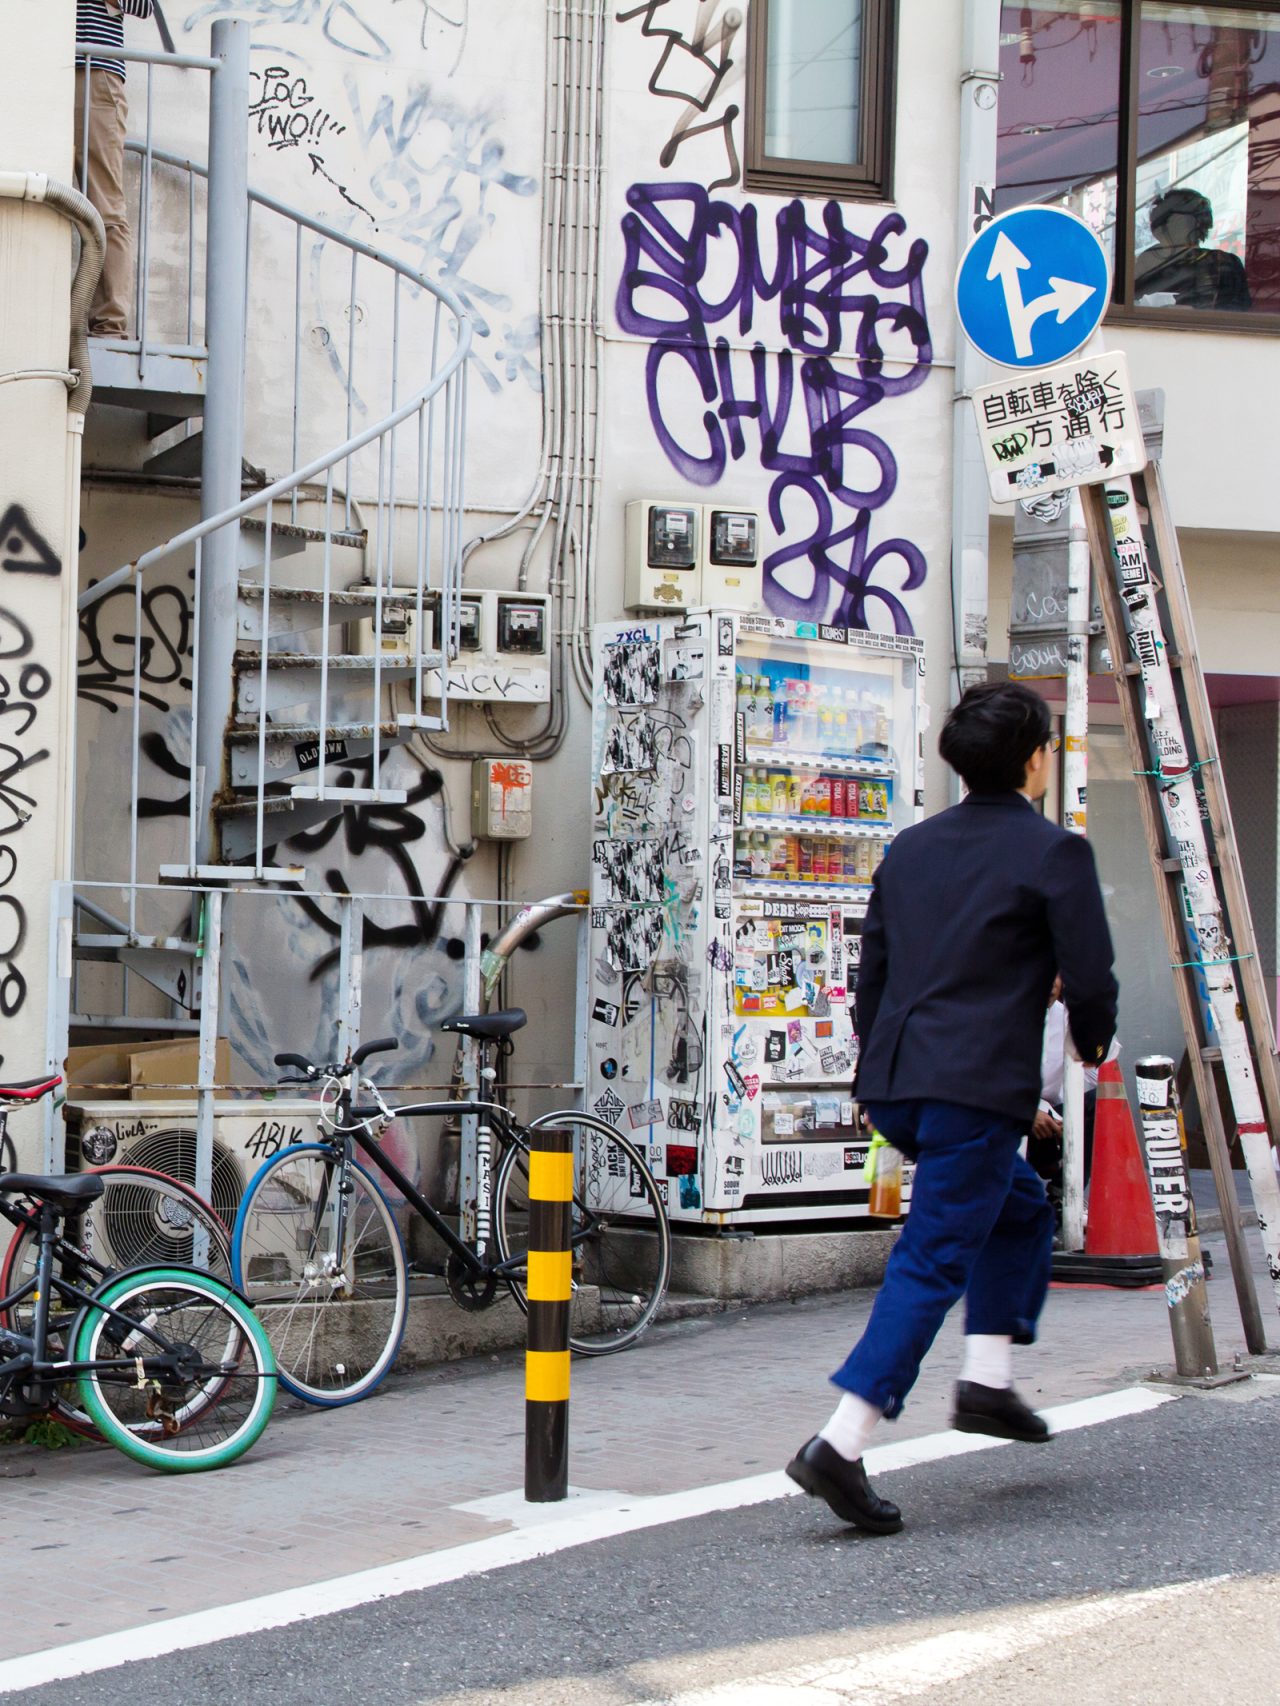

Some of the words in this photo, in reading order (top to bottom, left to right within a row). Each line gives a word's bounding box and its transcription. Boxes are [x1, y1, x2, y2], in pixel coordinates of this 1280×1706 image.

[982, 369, 1121, 424] 自転車を除く
[1026, 400, 1126, 448] 方通行
[300, 742, 342, 764] OLDOWN
[607, 1145, 619, 1177] JACK
[1142, 1118, 1190, 1214] RULER
